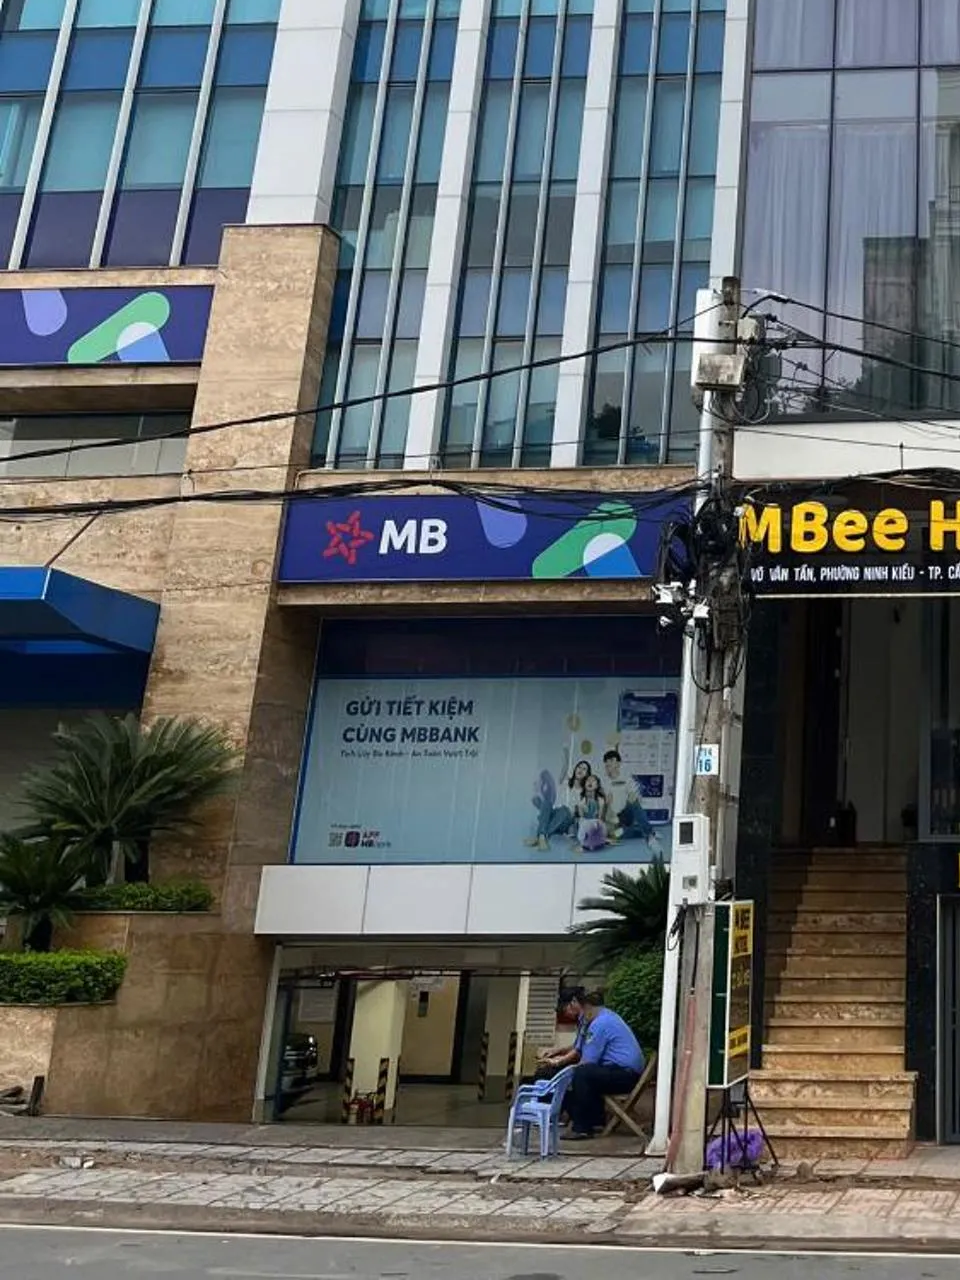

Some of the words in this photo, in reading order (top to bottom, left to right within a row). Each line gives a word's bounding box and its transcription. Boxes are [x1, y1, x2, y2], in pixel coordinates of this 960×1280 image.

[379, 518, 447, 554] MB
[739, 500, 909, 553] MBee
[386, 694, 425, 716] TIẾT
[428, 696, 474, 721] KIỆM
[343, 723, 396, 743] CÙNG
[400, 726, 480, 743] MBBANK
